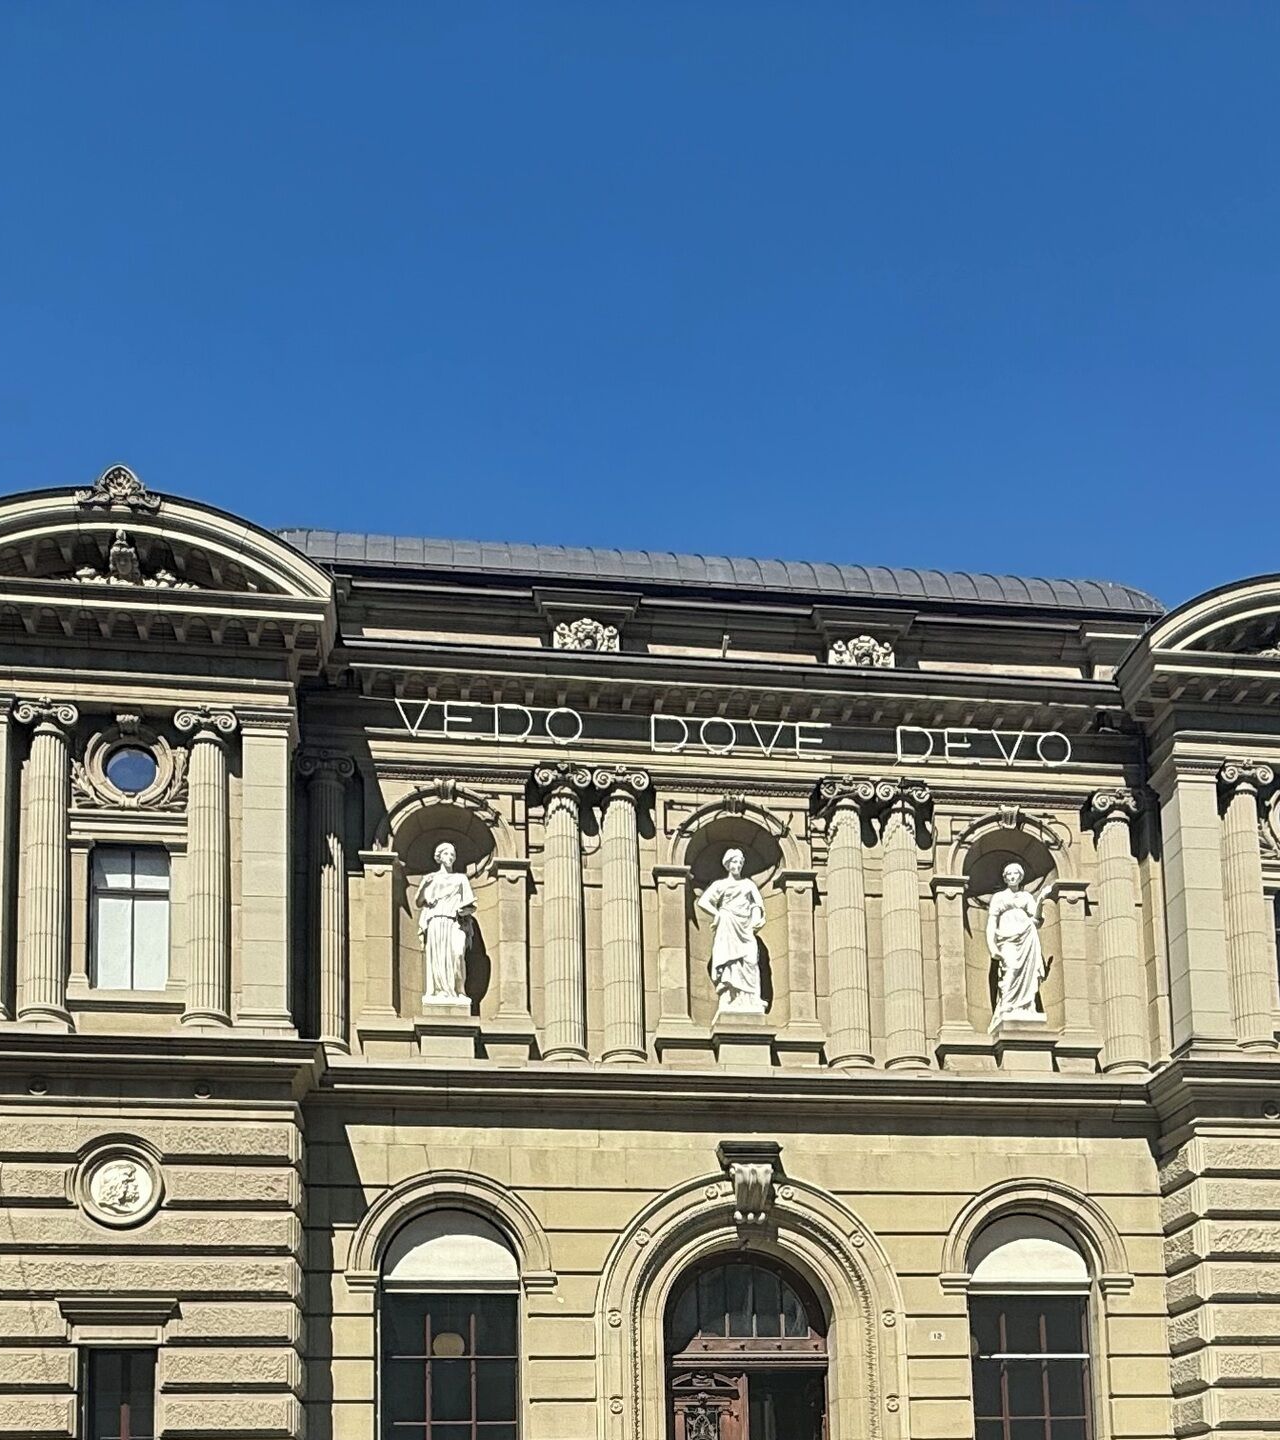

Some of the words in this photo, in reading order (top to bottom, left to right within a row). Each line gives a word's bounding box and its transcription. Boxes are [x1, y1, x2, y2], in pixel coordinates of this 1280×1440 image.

[394, 698, 583, 745] VEDO
[651, 714, 832, 760] DOVE
[894, 726, 1071, 768] DEVO
